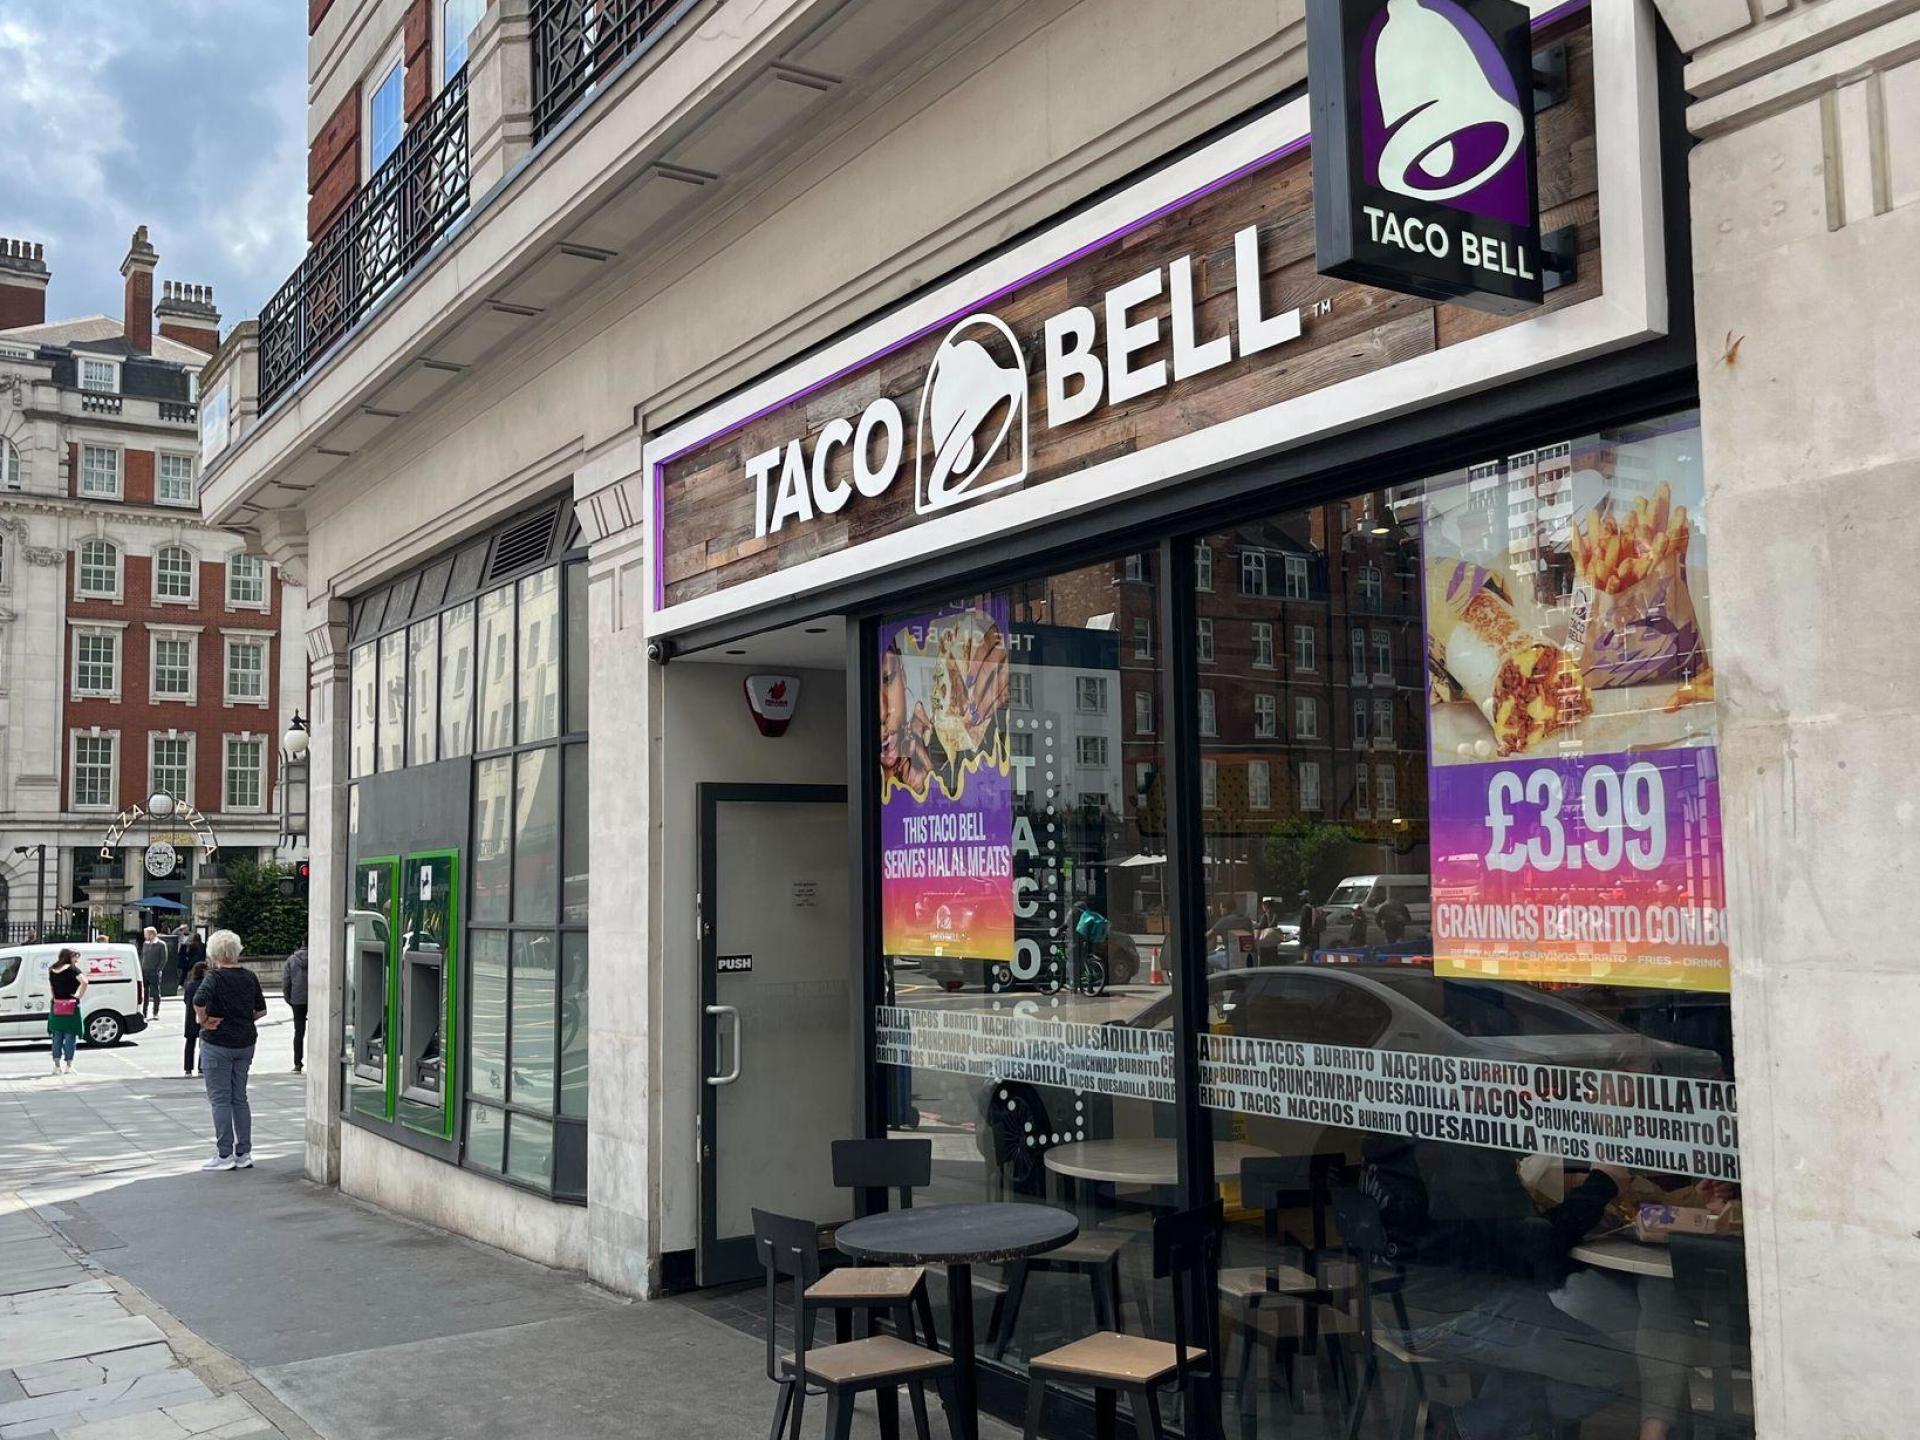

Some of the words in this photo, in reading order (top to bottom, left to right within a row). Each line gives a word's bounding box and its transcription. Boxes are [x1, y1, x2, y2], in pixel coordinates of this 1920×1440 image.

[1363, 206, 1449, 258] TACO
[1461, 230, 1535, 280] BELL
[745, 397, 902, 537] TACO
[1045, 225, 1300, 428] BELL
[100, 804, 144, 859] PIZZA
[176, 800, 217, 856] PIZZA
[903, 816, 928, 844] THIS
[928, 814, 956, 842] TACO
[959, 812, 986, 841] BELL
[1484, 762, 1667, 873] £3.99
[884, 848, 925, 879] SERVES
[928, 846, 966, 877] HALAL
[968, 845, 1010, 877] MEATS
[1436, 903, 1538, 942] CRAVINGS
[1543, 904, 1640, 943] BURRITO
[718, 958, 751, 969] PUSH
[1638, 955, 1672, 965] FRIES
[1682, 957, 1722, 968] DRINK
[911, 1010, 938, 1029] TACOS
[943, 1013, 978, 1031] BURRITO
[982, 1016, 1024, 1038] NACHOS
[1065, 1024, 1149, 1055] QUESADILLA
[972, 1037, 1025, 1058] QUESADILLA
[1027, 1039, 1065, 1064] TACOS
[1066, 1052, 1117, 1074] CRUNCHWRAP
[1118, 1057, 1159, 1077] BURRITO
[994, 1060, 1067, 1086] QUESADILLA
[1069, 1073, 1094, 1089] TACOS
[1097, 1078, 1146, 1097] QUESADILLA
[1200, 1035, 1256, 1066] ADILLA
[1257, 1041, 1305, 1067] TACOS
[1314, 1046, 1374, 1071] BURRITO
[1381, 1052, 1456, 1084] NACHOS
[1460, 1060, 1528, 1086] BURRITO
[1534, 1067, 1694, 1114] QUESADILLA
[1219, 1066, 1268, 1088] BURRITO
[1269, 1066, 1362, 1102] CRUNCHWRAP
[1364, 1079, 1460, 1113] QUESADILLA
[1461, 1085, 1533, 1121] TACOS
[1535, 1106, 1632, 1139] CRUNCHWRAP
[1634, 1115, 1714, 1146] BURRITO
[1241, 1091, 1281, 1115] TACOS
[1287, 1097, 1354, 1125] NACHOS
[1358, 1109, 1401, 1132] BURRITO
[1405, 1110, 1538, 1151] QUESADILLA
[1542, 1134, 1589, 1158] TACOS
[1595, 1142, 1688, 1172] QUESADILLA
[1693, 1149, 1740, 1179] BUR
